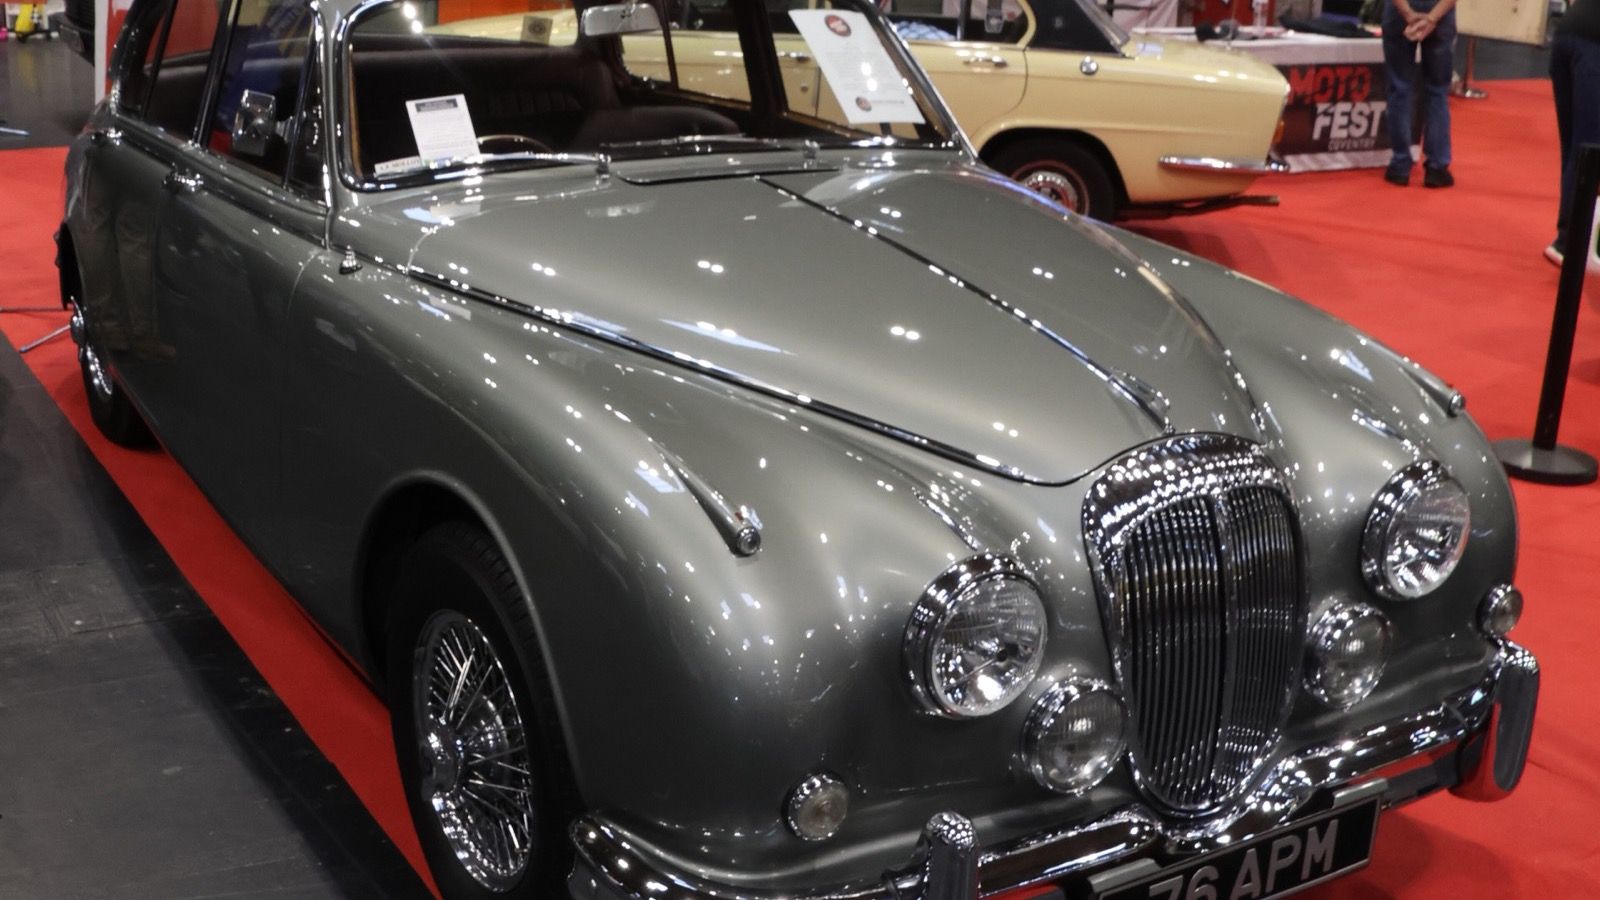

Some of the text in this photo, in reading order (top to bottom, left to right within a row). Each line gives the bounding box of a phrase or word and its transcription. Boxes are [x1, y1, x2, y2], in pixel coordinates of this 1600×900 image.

[1287, 64, 1371, 104] MOTO
[1312, 101, 1387, 140] FEST
[1229, 818, 1338, 900] APM
